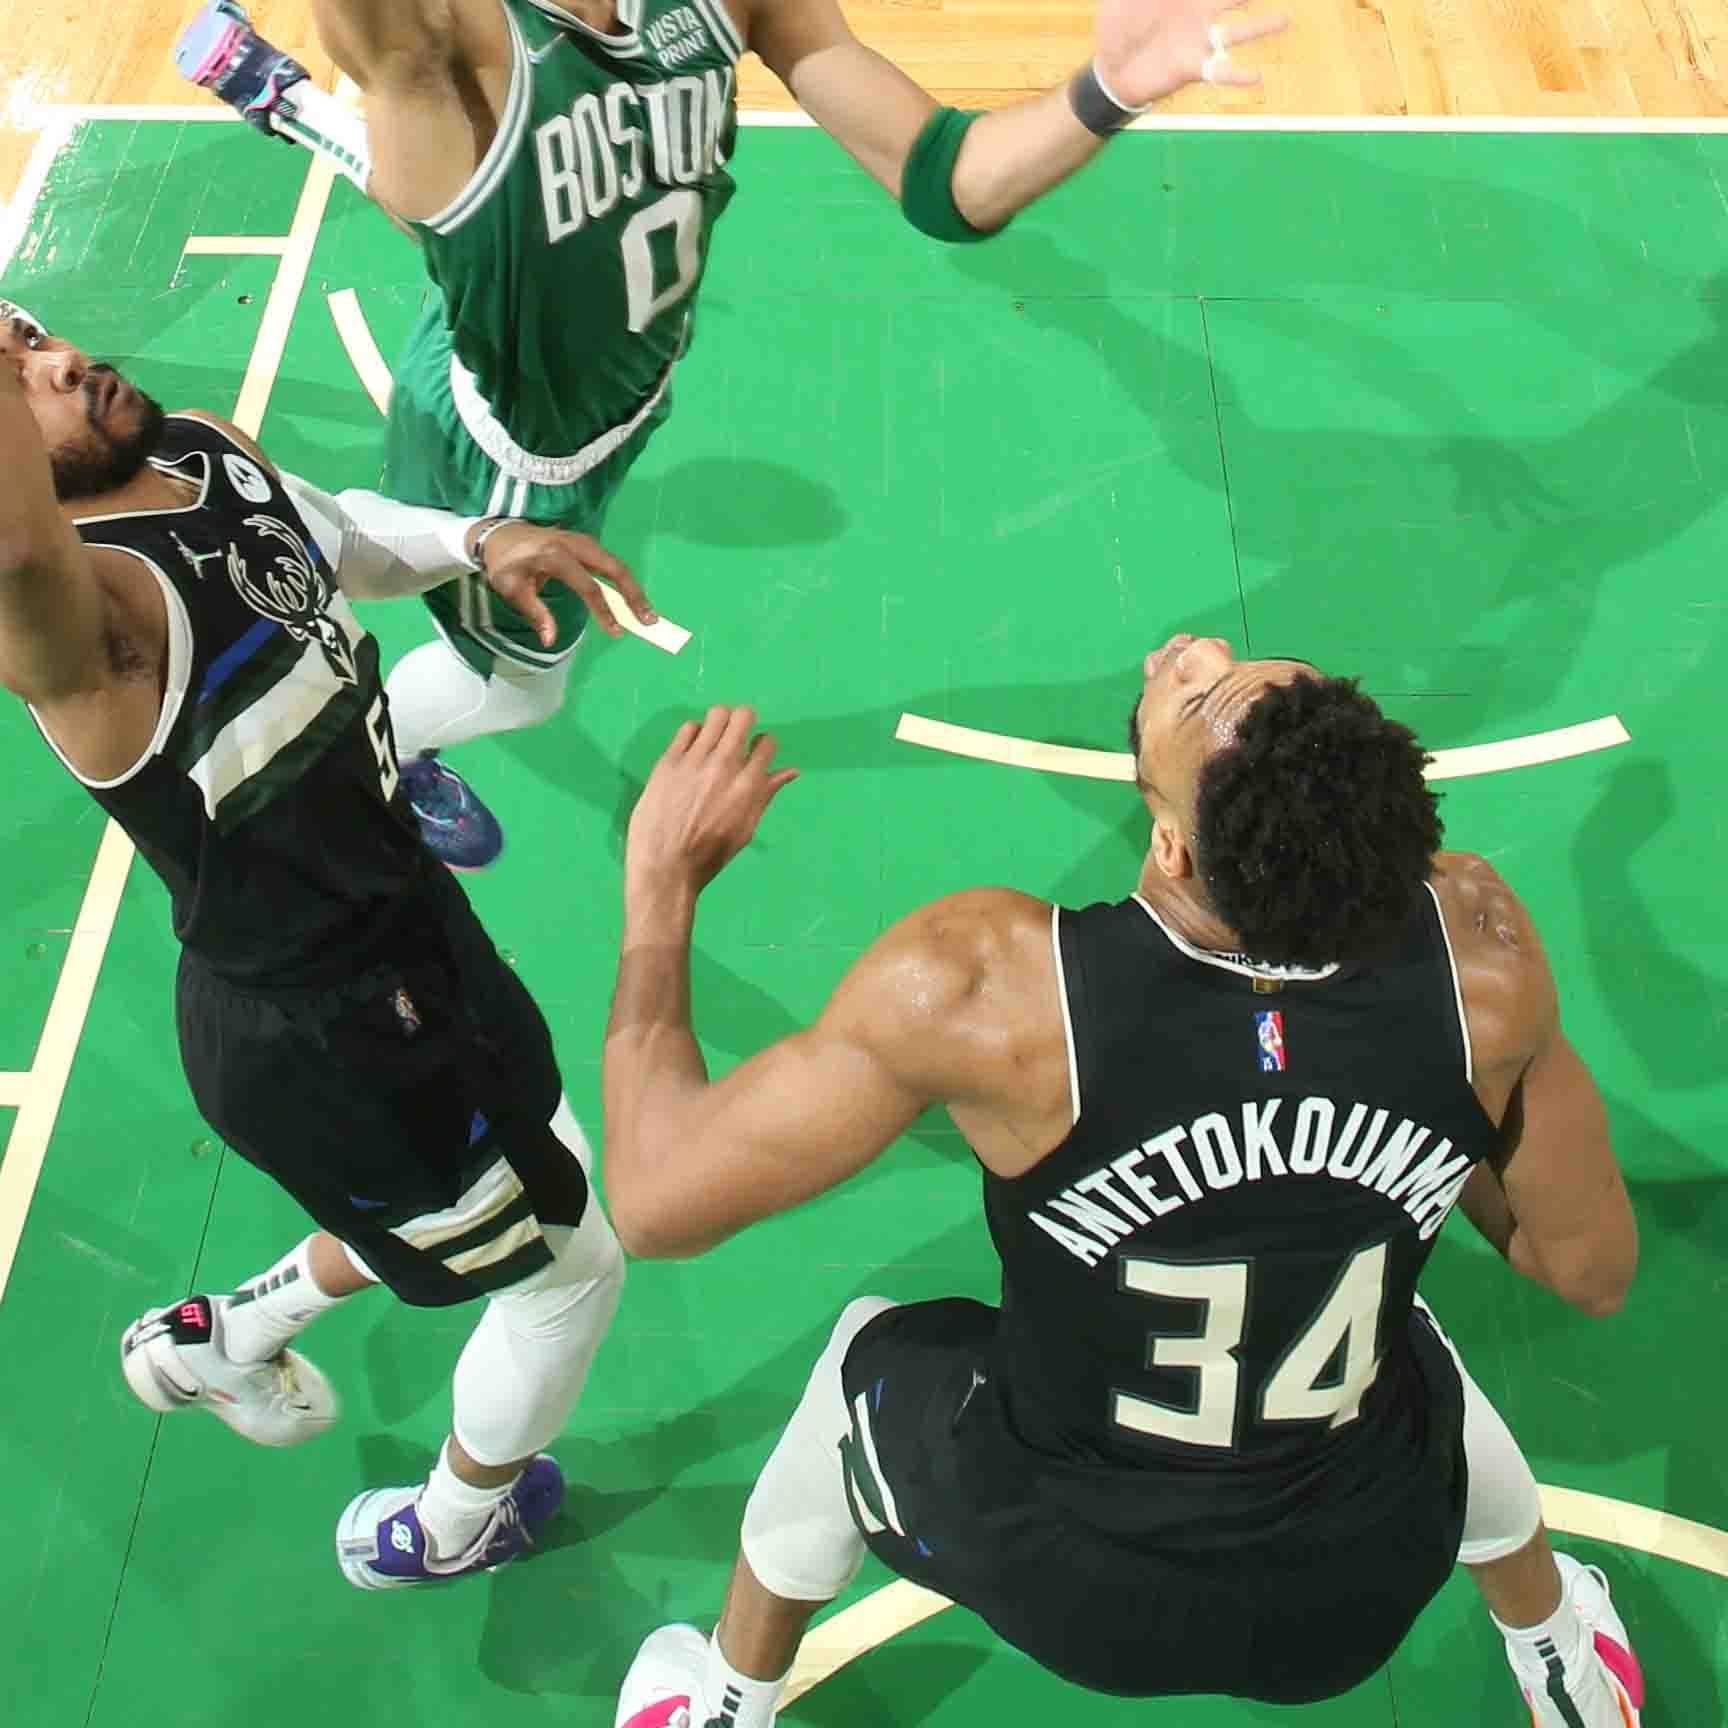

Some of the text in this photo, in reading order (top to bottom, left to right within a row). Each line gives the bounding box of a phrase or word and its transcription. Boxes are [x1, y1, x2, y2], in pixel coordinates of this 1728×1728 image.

[645, 6, 703, 50] VISTA
[656, 29, 709, 69] PRINT
[535, 68, 736, 245] BOSTON
[619, 188, 707, 335] 0
[1112, 1240, 1390, 1449] 34
